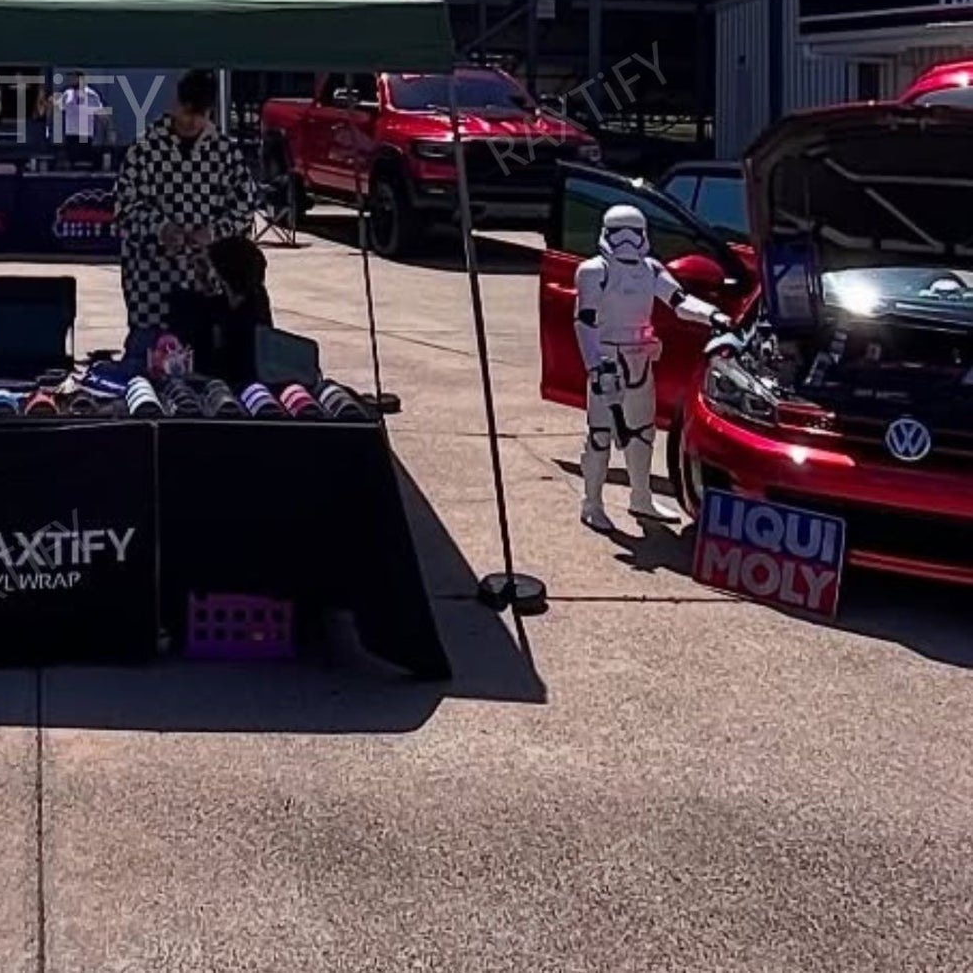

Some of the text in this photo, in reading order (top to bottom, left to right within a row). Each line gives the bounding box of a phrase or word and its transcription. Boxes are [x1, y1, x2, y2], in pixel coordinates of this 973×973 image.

[707, 495, 838, 562] LIQUI
[19, 572, 82, 589] WRAP
[701, 541, 837, 609] MOLY
